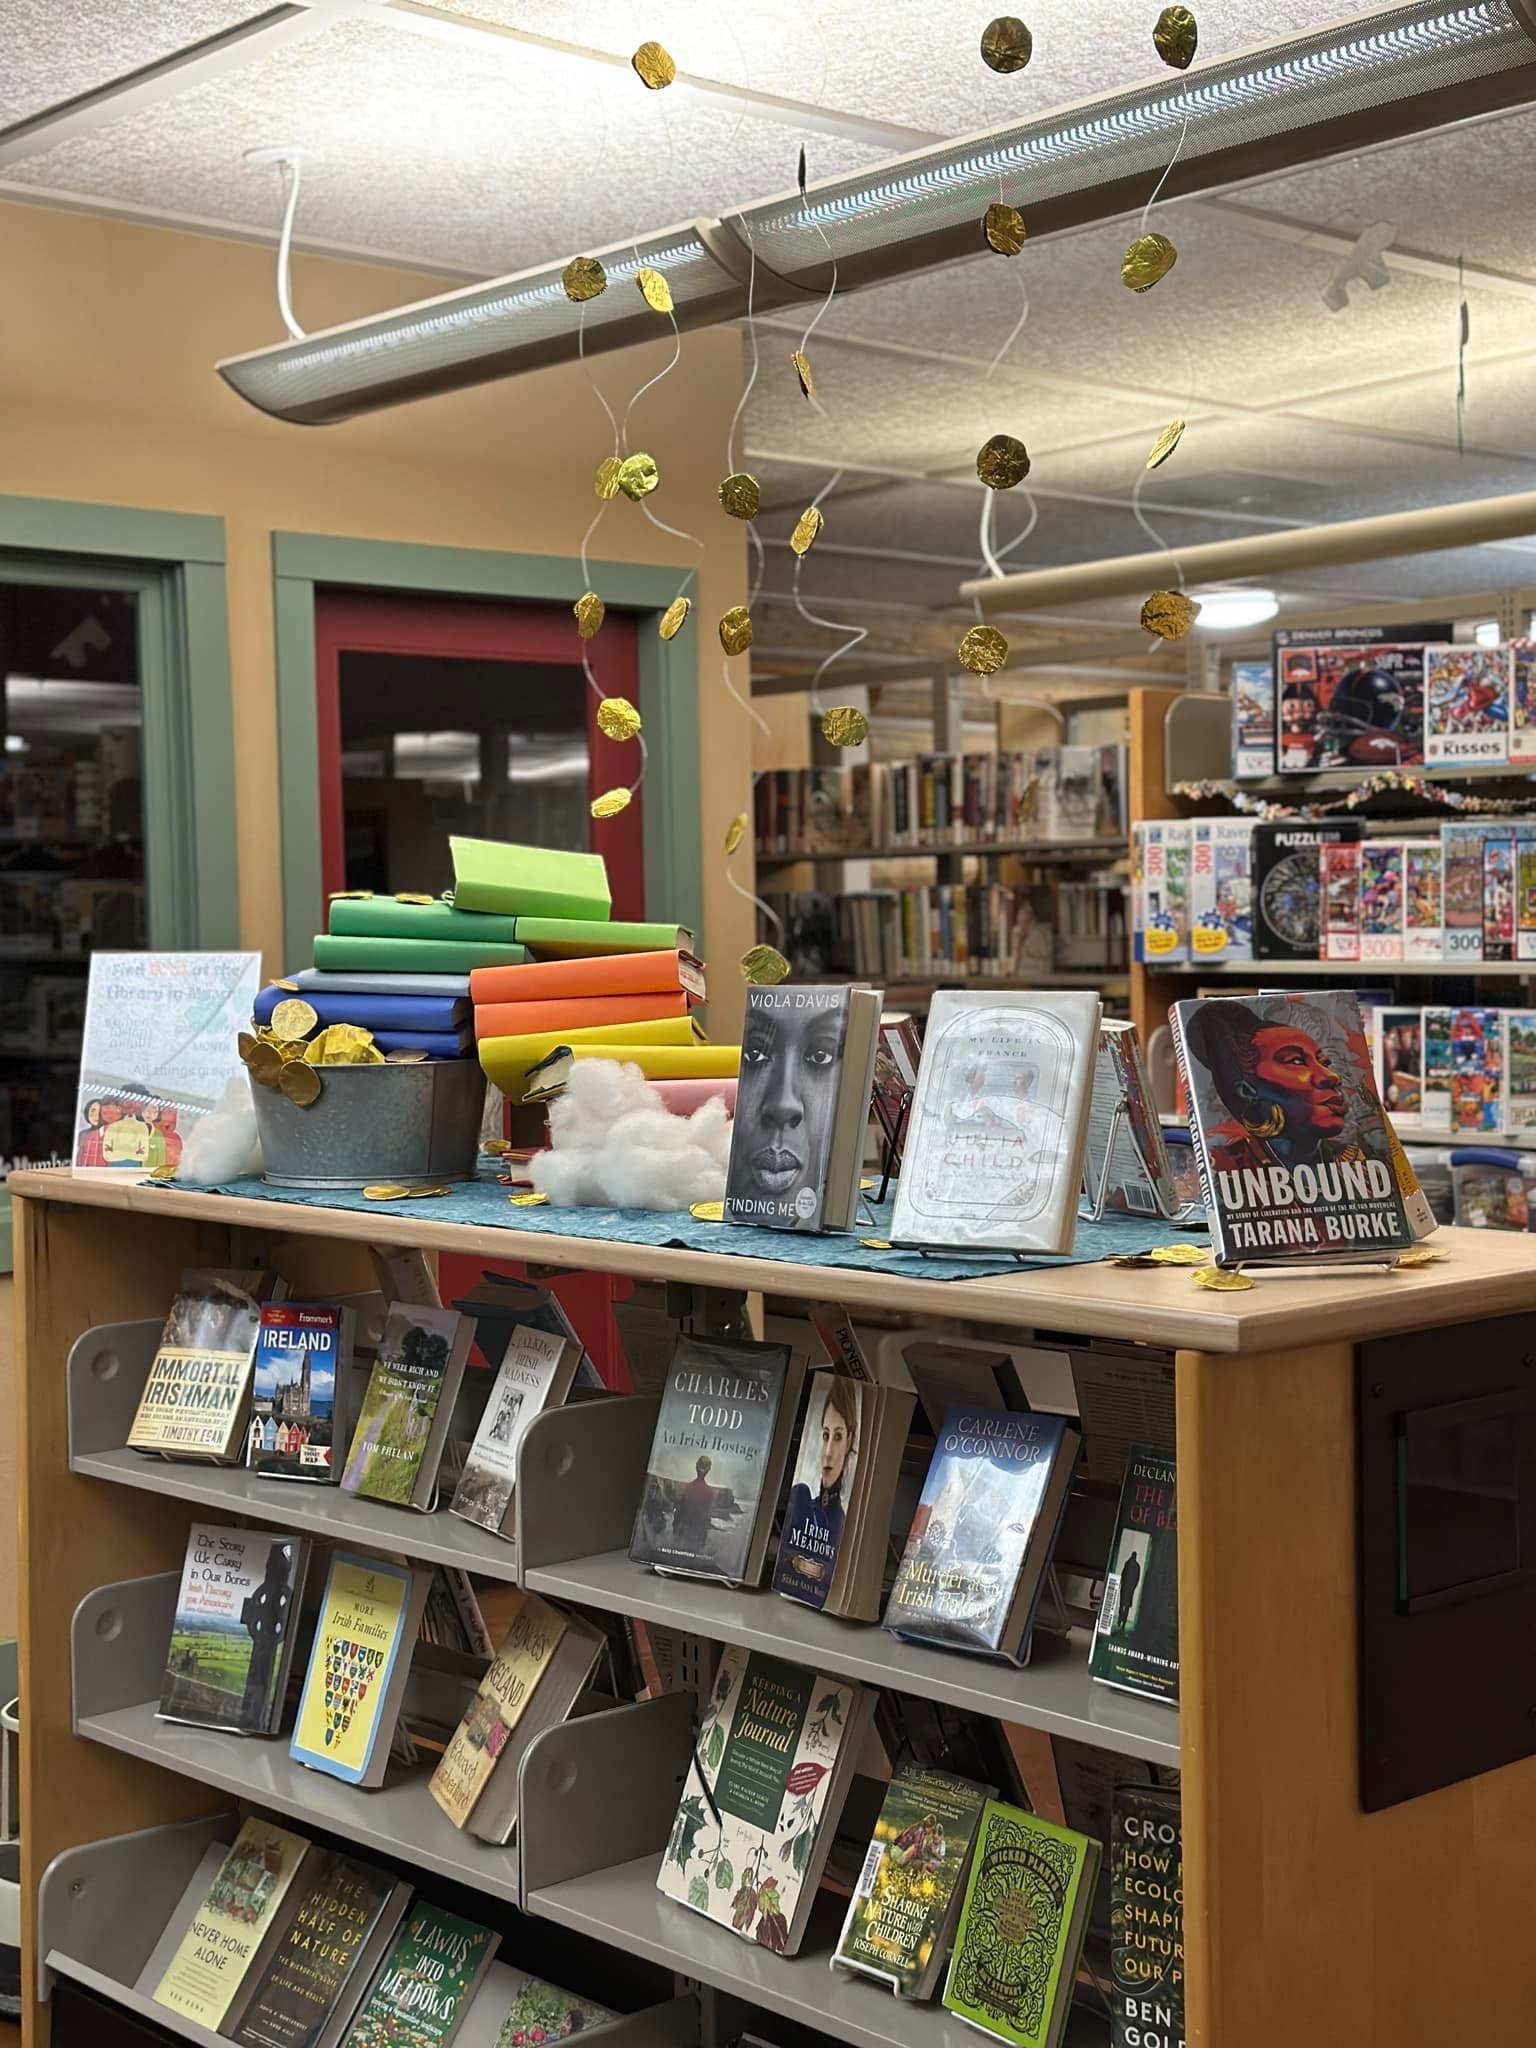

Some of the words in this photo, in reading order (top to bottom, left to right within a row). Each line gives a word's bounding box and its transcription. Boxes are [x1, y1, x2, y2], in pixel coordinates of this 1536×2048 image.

[1443, 741, 1501, 756] Kisses
[1275, 831, 1324, 847] PUZZLE
[1450, 934, 1482, 950] 300
[749, 993, 792, 1009] VIOLA
[795, 993, 840, 1009] DAVIS
[943, 1152, 1024, 1169] CHILD
[1218, 1159, 1392, 1211] UNBOUND
[725, 1197, 776, 1216] FINDING
[778, 1202, 796, 1217] ME
[1228, 1217, 1320, 1249] TARANA
[1324, 1211, 1402, 1242] BURKE
[299, 1312, 333, 1325] Frommer's
[263, 1329, 332, 1352] IRELAND
[153, 1358, 241, 1386] IMMORTAL
[408, 1365, 425, 1376] RICH
[425, 1368, 439, 1378] AND
[144, 1381, 238, 1411] IRISHMAN
[673, 1370, 770, 1403] CHARLES
[688, 1403, 744, 1431] TODD
[957, 1415, 1041, 1442] CARLENE
[161, 1425, 200, 1441] TIMOTHY
[200, 1428, 225, 1444] EGAN
[679, 1430, 708, 1450] Irish
[711, 1435, 762, 1461] Hostage
[943, 1433, 1041, 1463] O'CONNOR
[361, 1439, 379, 1454] TOM
[380, 1443, 415, 1462] PHELAN
[1133, 1463, 1176, 1484] DECLAN
[1135, 1483, 1166, 1507] THE
[1129, 1504, 1152, 1526] OF
[789, 1527, 836, 1560] MEADOWS
[803, 1517, 830, 1542] IRISH
[197, 1534, 215, 1549] The
[219, 1536, 246, 1556] Story
[193, 1550, 211, 1565] We
[213, 1553, 242, 1573] Carry
[904, 1559, 966, 1590] Murder
[190, 1568, 199, 1580] in
[224, 1571, 250, 1587] Bones
[353, 1602, 375, 1617] MORE
[897, 1583, 934, 1609] Irish
[332, 1610, 353, 1629] Irish
[352, 1617, 390, 1641] Families
[486, 1656, 527, 1709] IRELAND
[752, 1675, 794, 1701] KEEPING
[742, 1687, 799, 1728] Nature
[733, 1711, 796, 1755] Journal
[1123, 1815, 1183, 1847] CRO
[990, 1848, 1027, 1864] WICKED
[1027, 1854, 1060, 1891] PLANTS
[1123, 1851, 1170, 1874] HOW
[335, 1878, 364, 1899] THE
[880, 1885, 931, 1920] SHARING
[1124, 1876, 1184, 1905] ECOLO
[310, 1892, 369, 1926] HIDDEN
[863, 1898, 907, 1928] NATURE
[906, 1918, 924, 1935] with
[1123, 1903, 1180, 1932] SHAPI
[191, 1921, 222, 1947] NEVER
[219, 1934, 251, 1960] HOME
[296, 1909, 337, 1936] HALF
[341, 1928, 363, 1947] OF
[412, 1919, 473, 1964] LAWNS
[864, 1921, 919, 1951] CHILDREN
[193, 1945, 229, 1972] ALONE
[289, 1931, 350, 1967] NATURE
[852, 1937, 879, 1956] JOSEPH
[878, 1947, 910, 1969] CORNELL
[1124, 1931, 1184, 1959] FUTUR
[415, 1953, 446, 1982] INTO
[1123, 1957, 1164, 1982] OUR
[379, 1967, 456, 2021] MEADOWS
[990, 1978, 1022, 1997] STEWART
[1125, 1997, 1172, 2029] BEN
